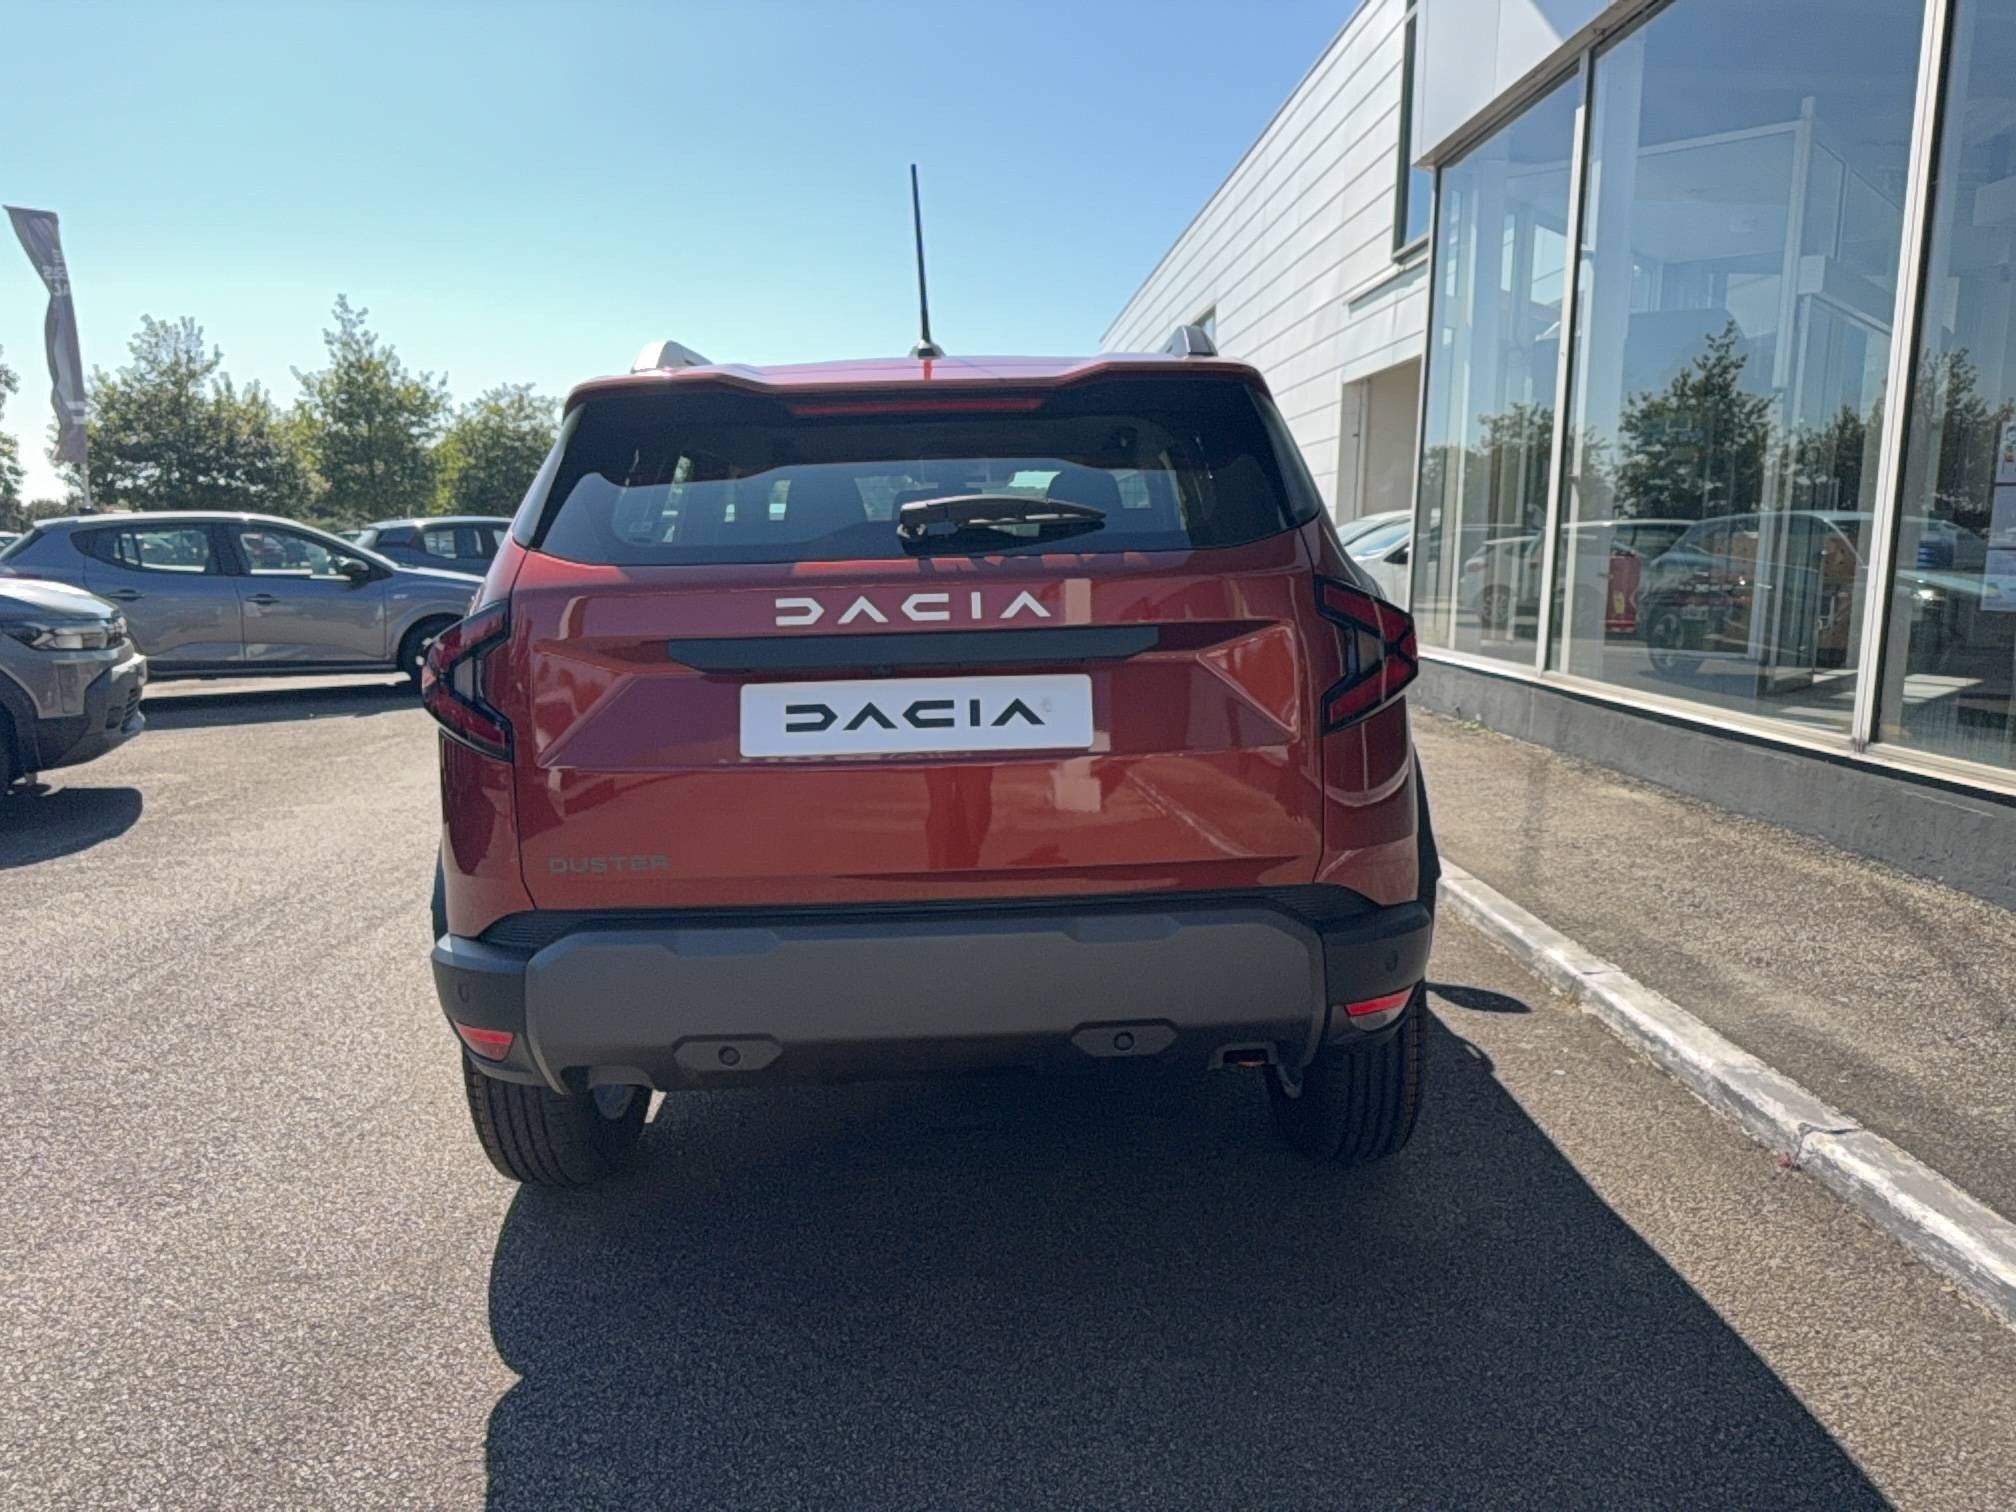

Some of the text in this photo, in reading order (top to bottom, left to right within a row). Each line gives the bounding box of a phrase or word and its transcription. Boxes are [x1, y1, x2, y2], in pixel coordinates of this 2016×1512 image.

[775, 590, 1051, 627] DACIA
[785, 697, 1045, 733] DACIA
[548, 856, 670, 873] DUSTER
